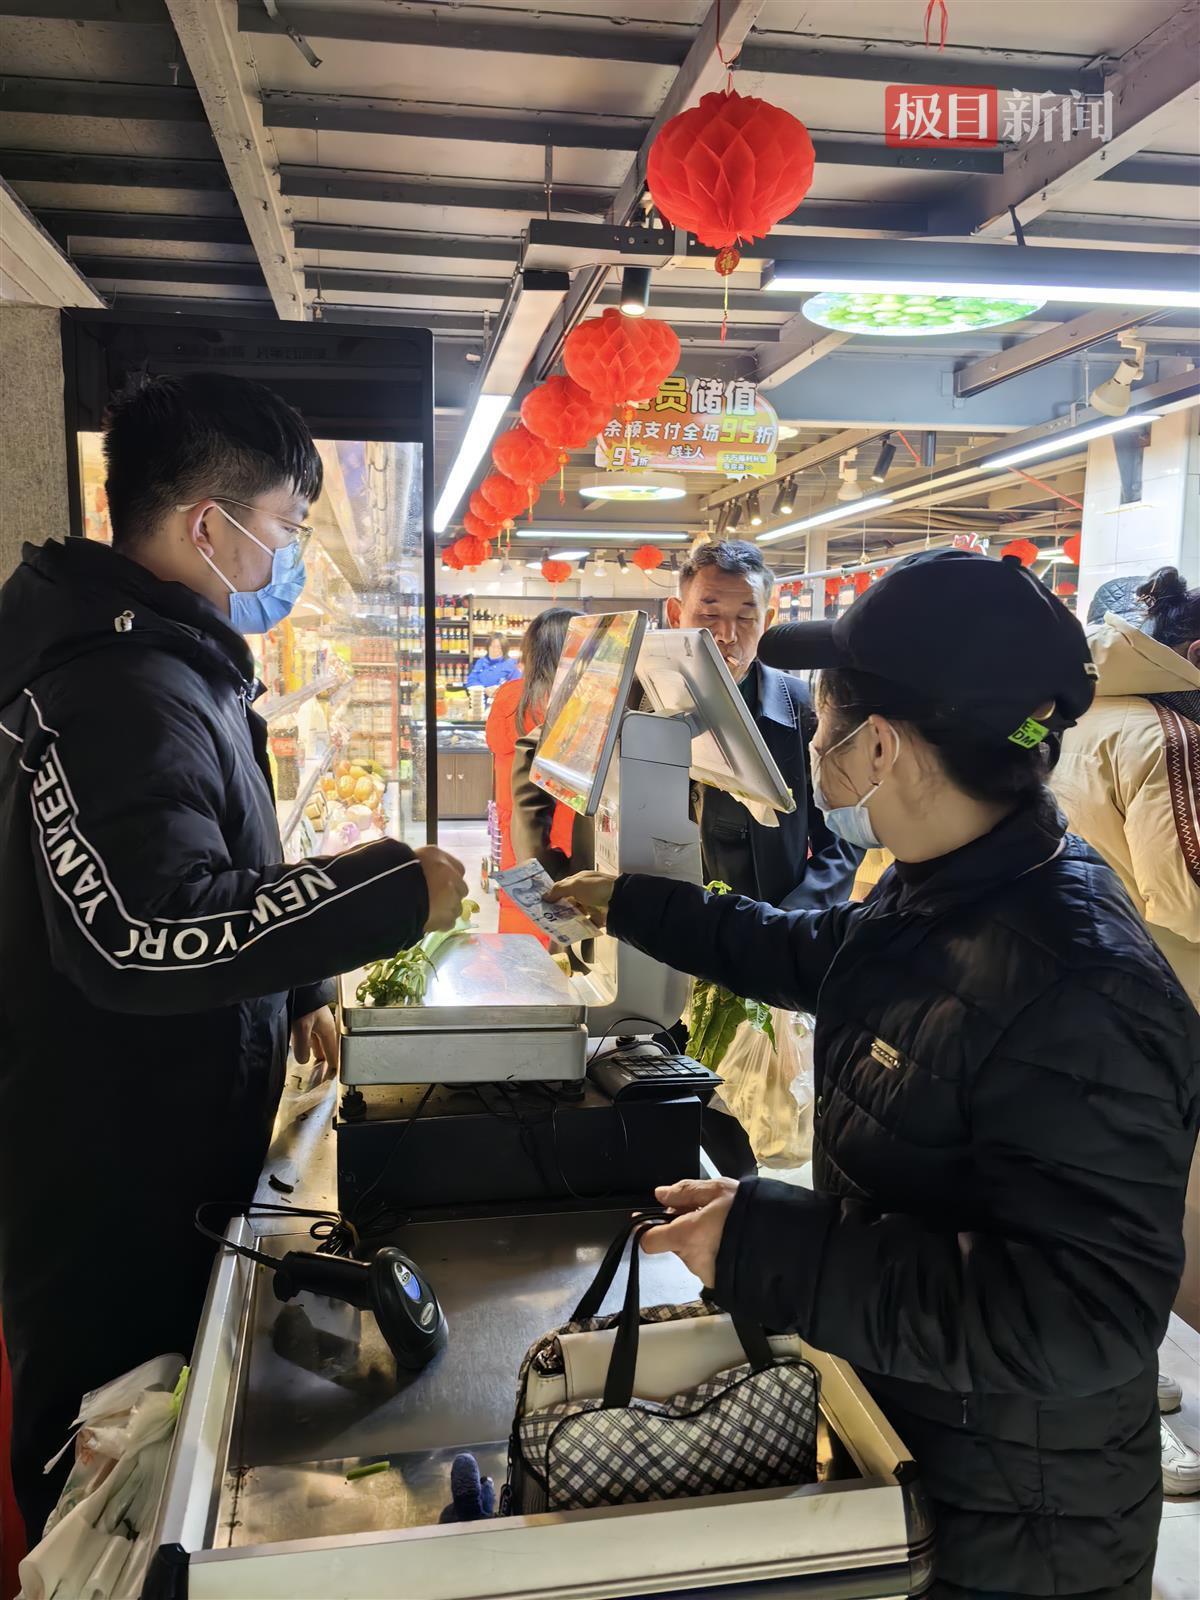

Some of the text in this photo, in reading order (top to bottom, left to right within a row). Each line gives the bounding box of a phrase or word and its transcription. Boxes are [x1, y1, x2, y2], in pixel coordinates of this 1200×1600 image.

[636, 376, 758, 416] 员储值
[604, 418, 776, 444] 余额支付全场95折
[32, 756, 106, 925] YANKEE
[249, 873, 337, 932] NEW
